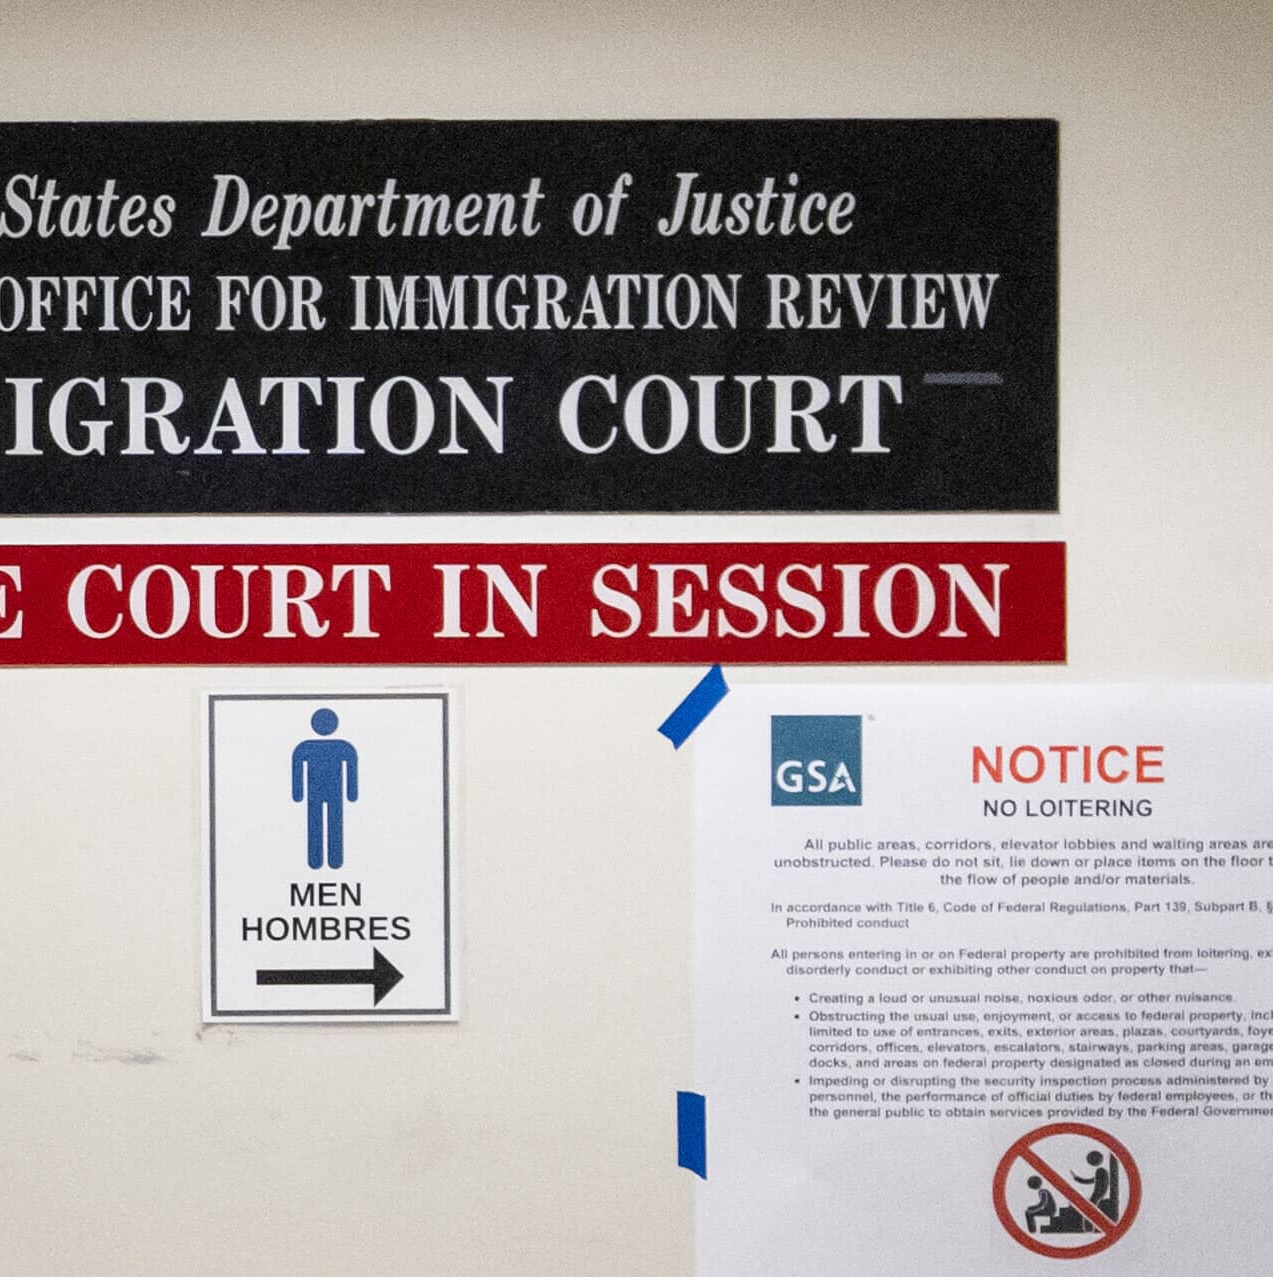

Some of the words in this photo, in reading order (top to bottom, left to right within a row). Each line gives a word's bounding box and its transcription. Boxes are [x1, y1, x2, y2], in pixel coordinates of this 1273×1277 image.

[200, 174, 545, 251] Department
[572, 172, 633, 237] of
[657, 172, 856, 237] Justice
[215, 275, 327, 332] FOR
[350, 273, 742, 331] IMMIGRATION
[766, 273, 1000, 329] REVIEW
[558, 374, 903, 455] COURT
[67, 563, 392, 639] COURT
[433, 564, 547, 638] IN
[591, 563, 1010, 639] SESSION
[776, 759, 856, 793] GSA
[972, 745, 1165, 784] NOTICE
[983, 799, 1017, 817] NO
[1026, 798, 1153, 818] LOITERING
[803, 838, 824, 851] All
[827, 838, 873, 854] public
[1000, 838, 1059, 851] elevator
[1063, 838, 1117, 851] lobbies
[1120, 838, 1148, 851] and
[1151, 838, 1205, 854] waiting
[1208, 840, 1248, 850] areas
[879, 855, 928, 868] Please
[931, 855, 951, 868] do
[954, 856, 979, 868] not
[1009, 855, 1026, 868] lie
[1030, 856, 1070, 868] down
[1074, 858, 1089, 868] or
[1093, 855, 1133, 871] place
[1136, 855, 1177, 868] items
[1180, 857, 1200, 868] on
[1203, 855, 1227, 868] the
[1230, 853, 1265, 868] floor
[939, 873, 963, 886] the
[966, 872, 998, 886] flow
[1001, 873, 1017, 886] of
[1020, 873, 1070, 889] people
[1073, 873, 1121, 886] and/or
[290, 882, 361, 907] MEN
[242, 916, 411, 942] HOMBRES
[785, 916, 854, 929] Prohibited
[856, 917, 910, 929] conduct
